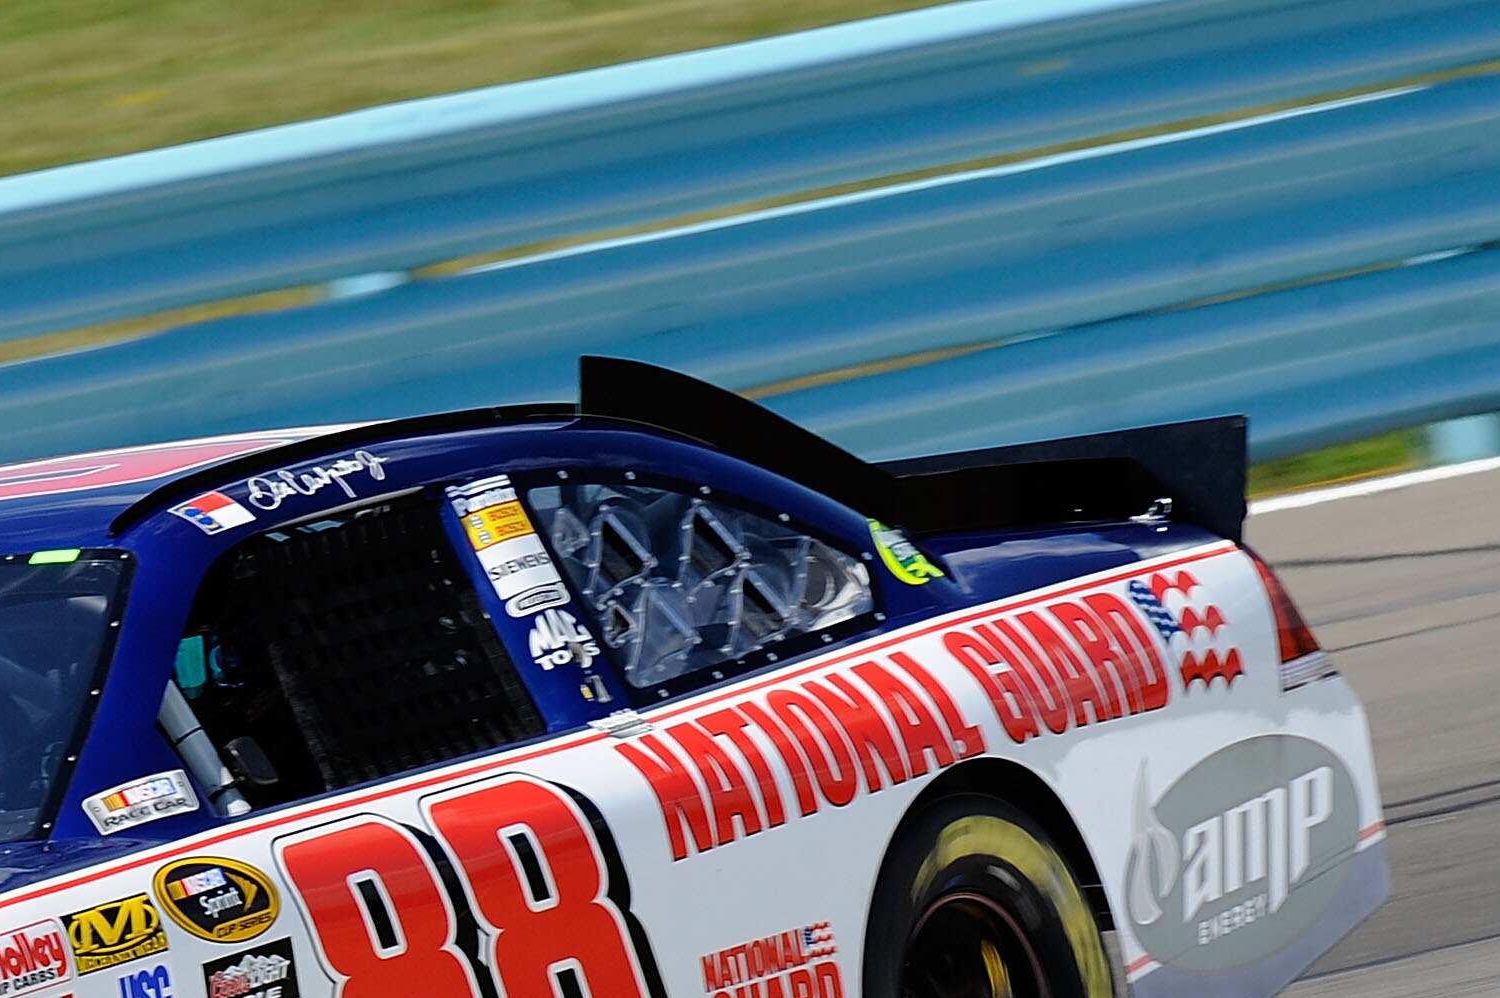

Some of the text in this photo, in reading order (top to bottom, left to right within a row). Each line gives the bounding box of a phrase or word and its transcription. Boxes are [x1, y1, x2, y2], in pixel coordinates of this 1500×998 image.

[614, 592, 1173, 862] NATIONAL GUARD
[153, 797, 188, 812] CAR
[12, 968, 56, 991] CARBS
[701, 927, 810, 993] NATIONAL
